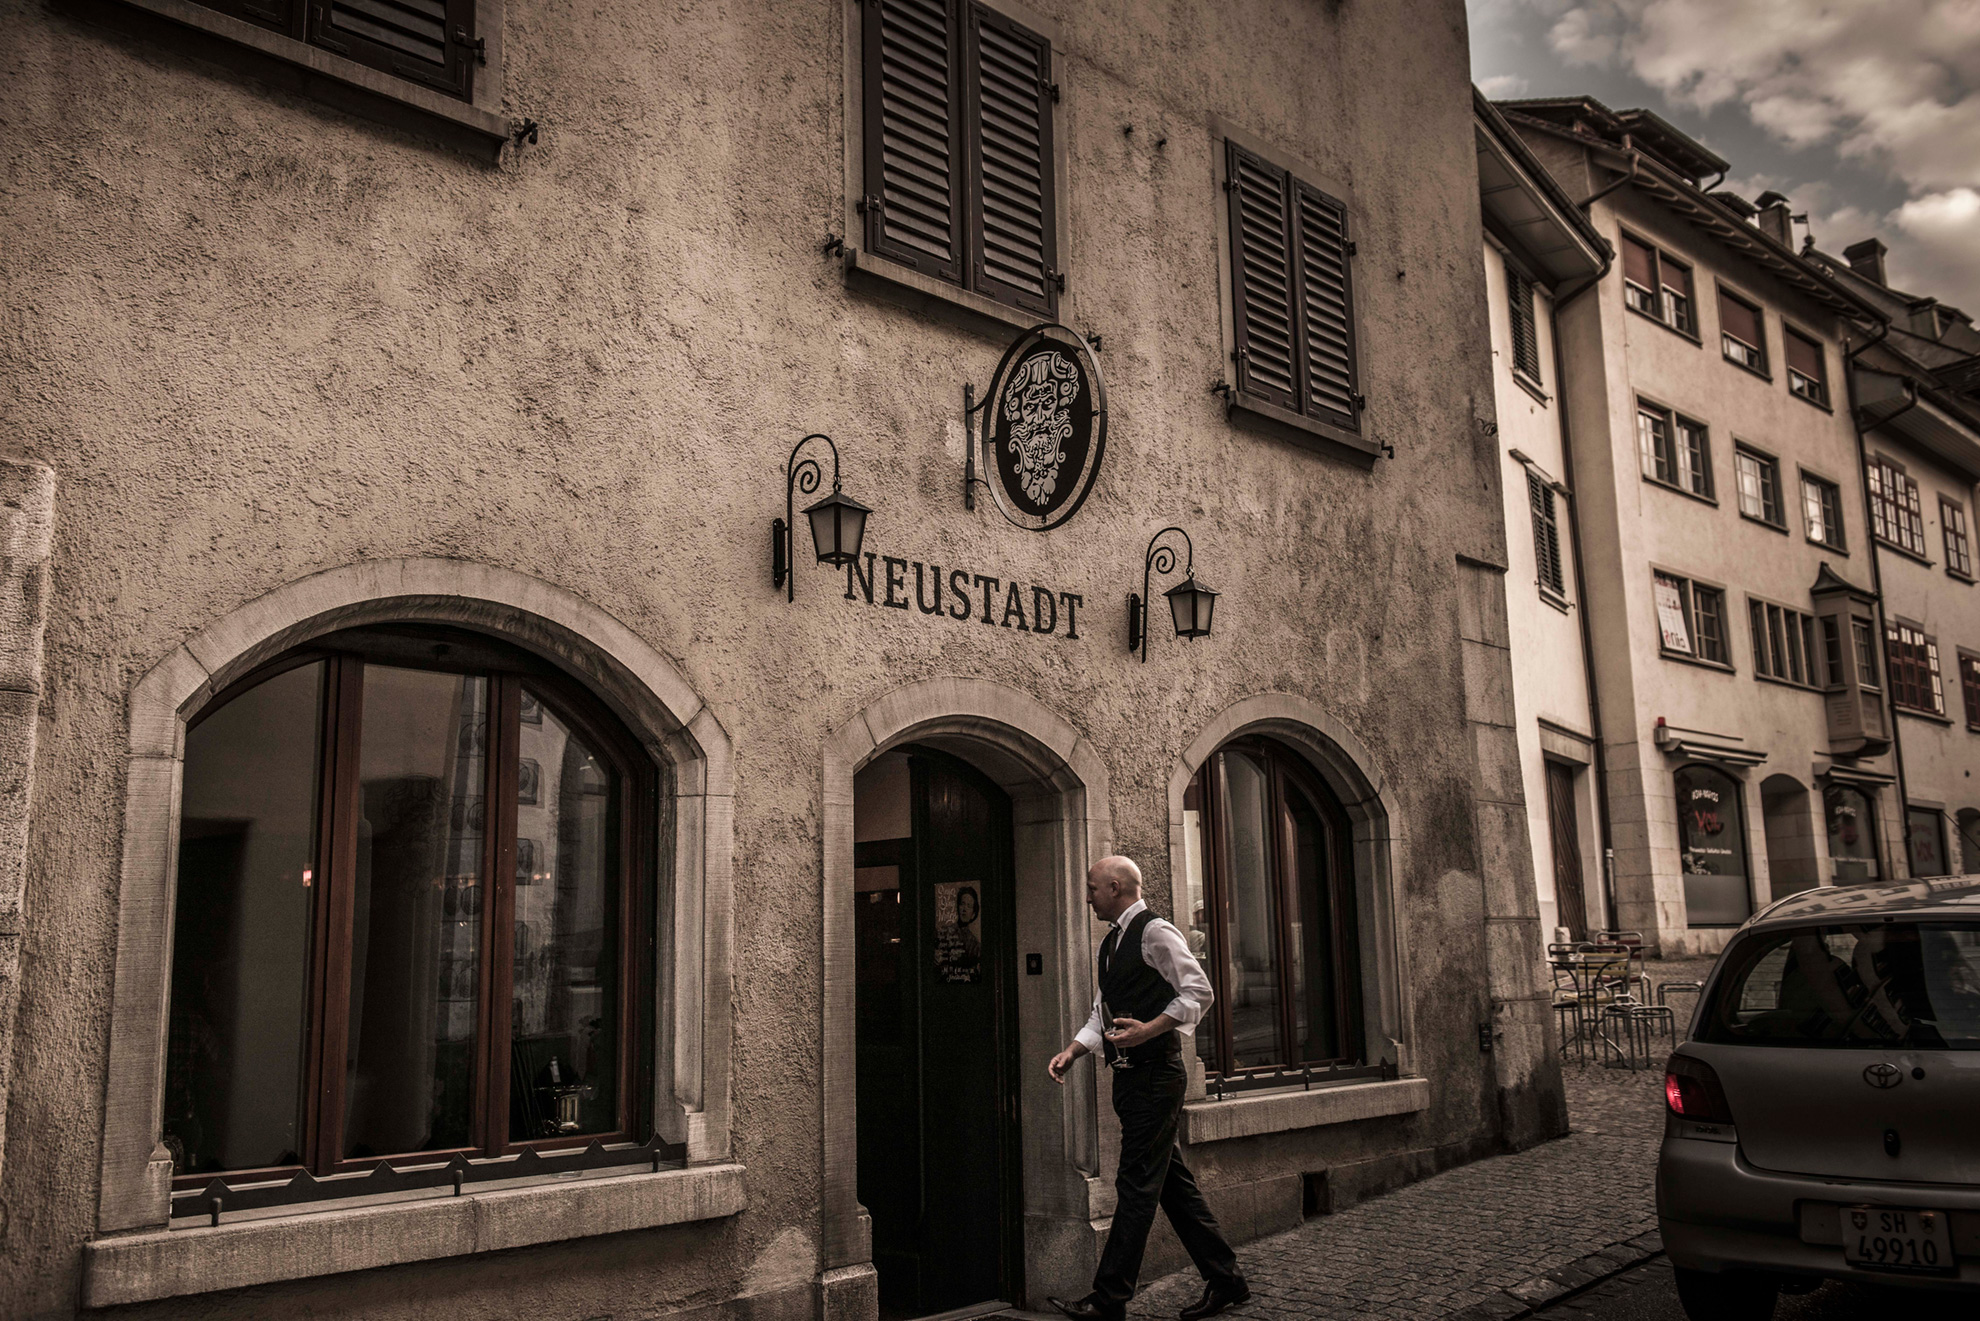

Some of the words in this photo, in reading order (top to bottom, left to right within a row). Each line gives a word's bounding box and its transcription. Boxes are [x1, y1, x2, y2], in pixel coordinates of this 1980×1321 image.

[843, 551, 1083, 639] NEUSTADT
[1880, 1212, 1907, 1233] SH
[1858, 1235, 1937, 1265] 49910
